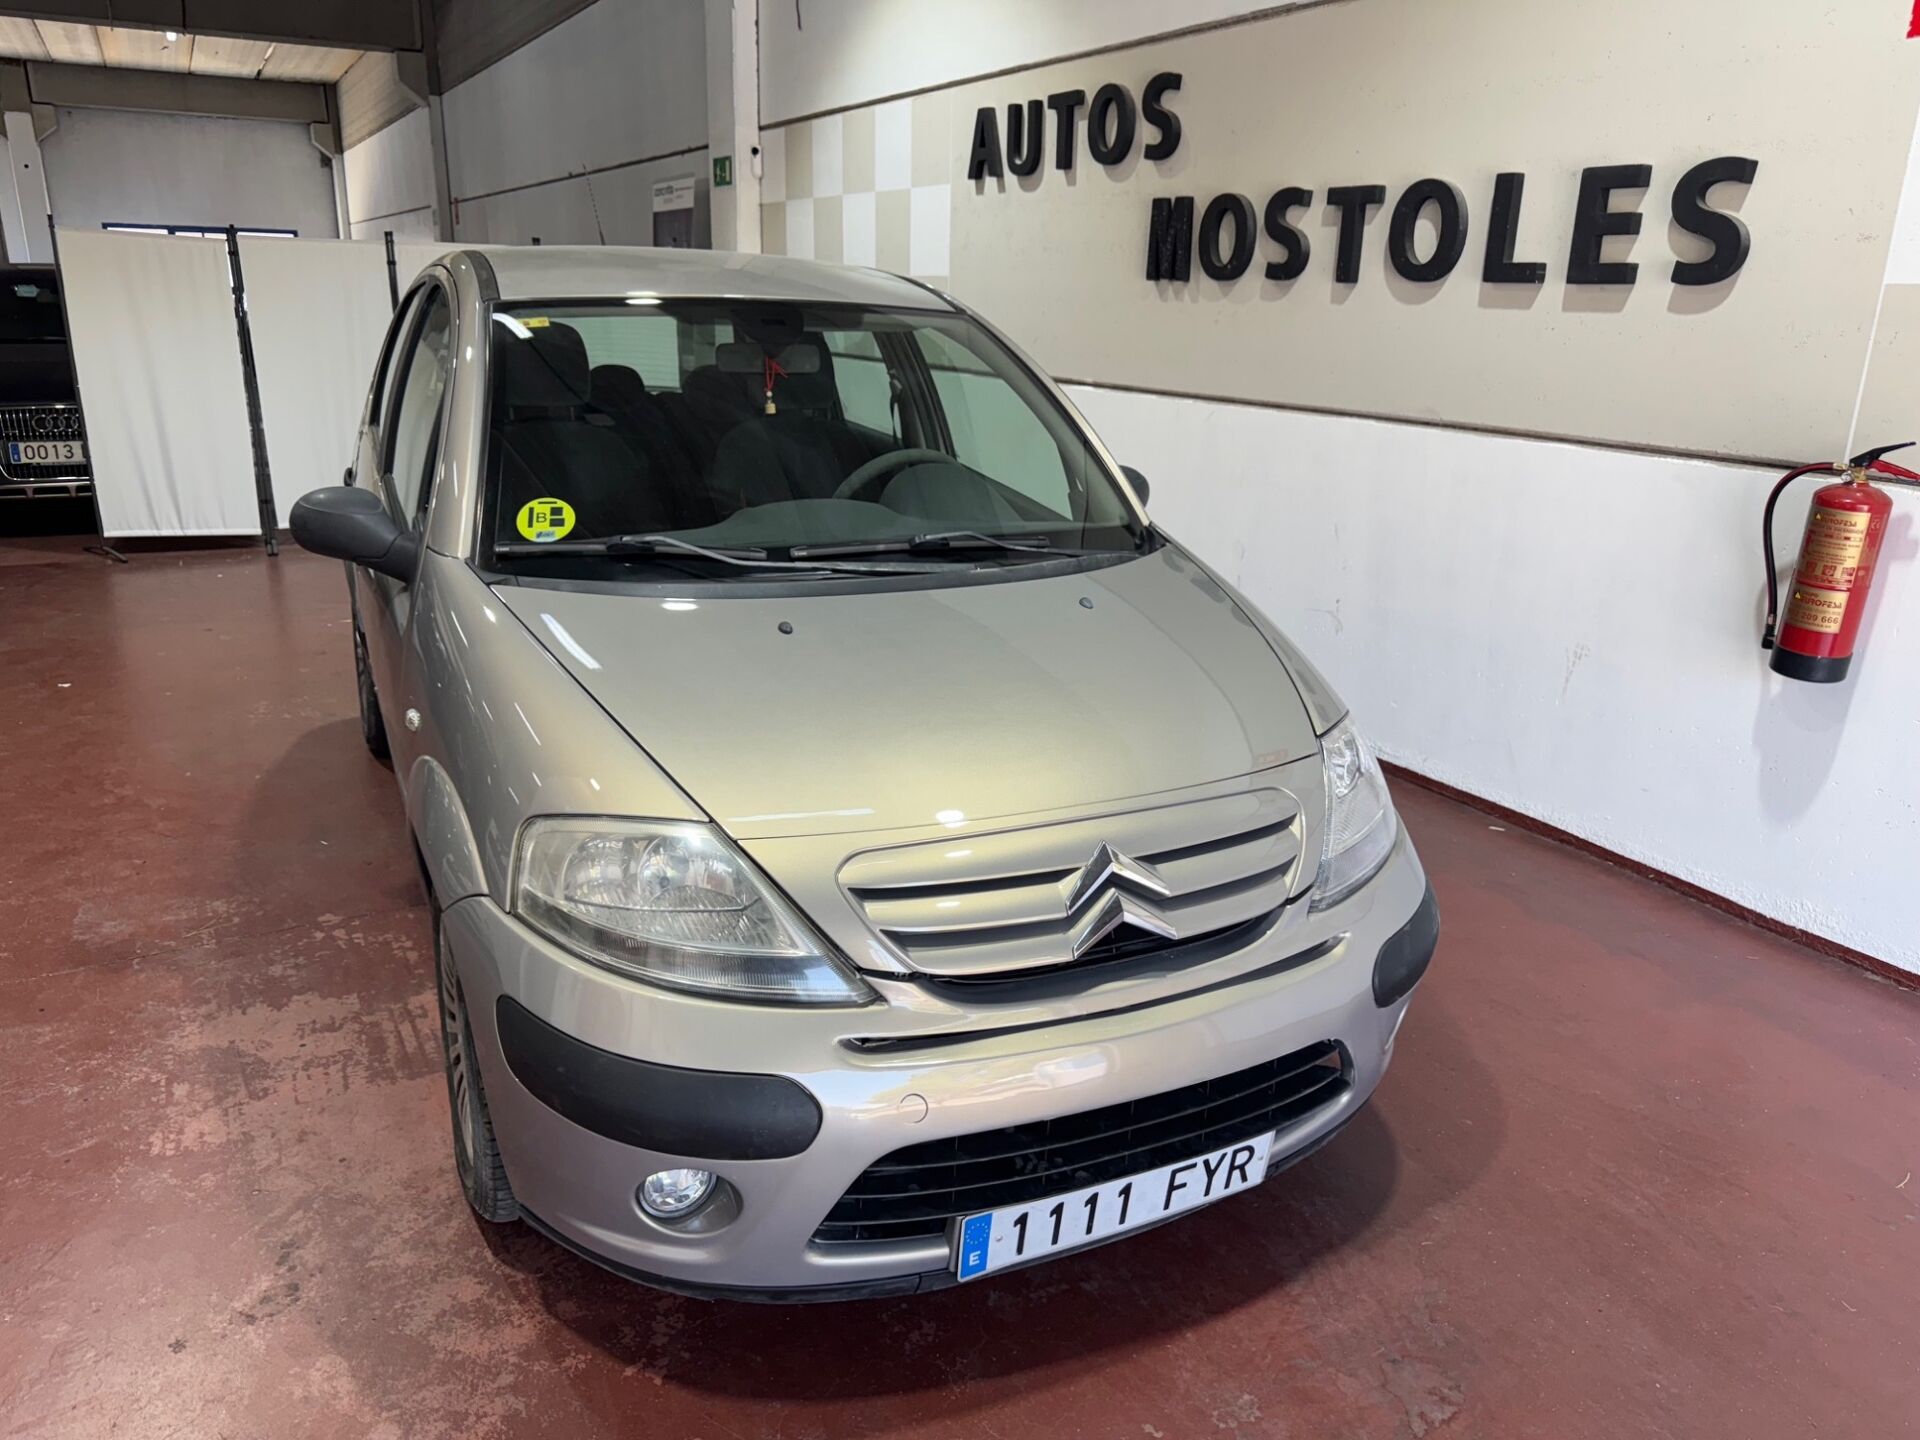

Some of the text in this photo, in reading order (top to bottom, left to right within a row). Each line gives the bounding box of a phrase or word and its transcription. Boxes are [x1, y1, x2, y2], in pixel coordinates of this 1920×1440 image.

[968, 72, 1183, 180] AUTOS
[1146, 156, 1759, 286] MOSTOLES
[24, 444, 75, 461] 0013
[535, 512, 547, 523] B
[1821, 615, 1840, 625] 666
[1012, 1144, 1256, 1256] 1111 FYR
[968, 1250, 982, 1267] E
